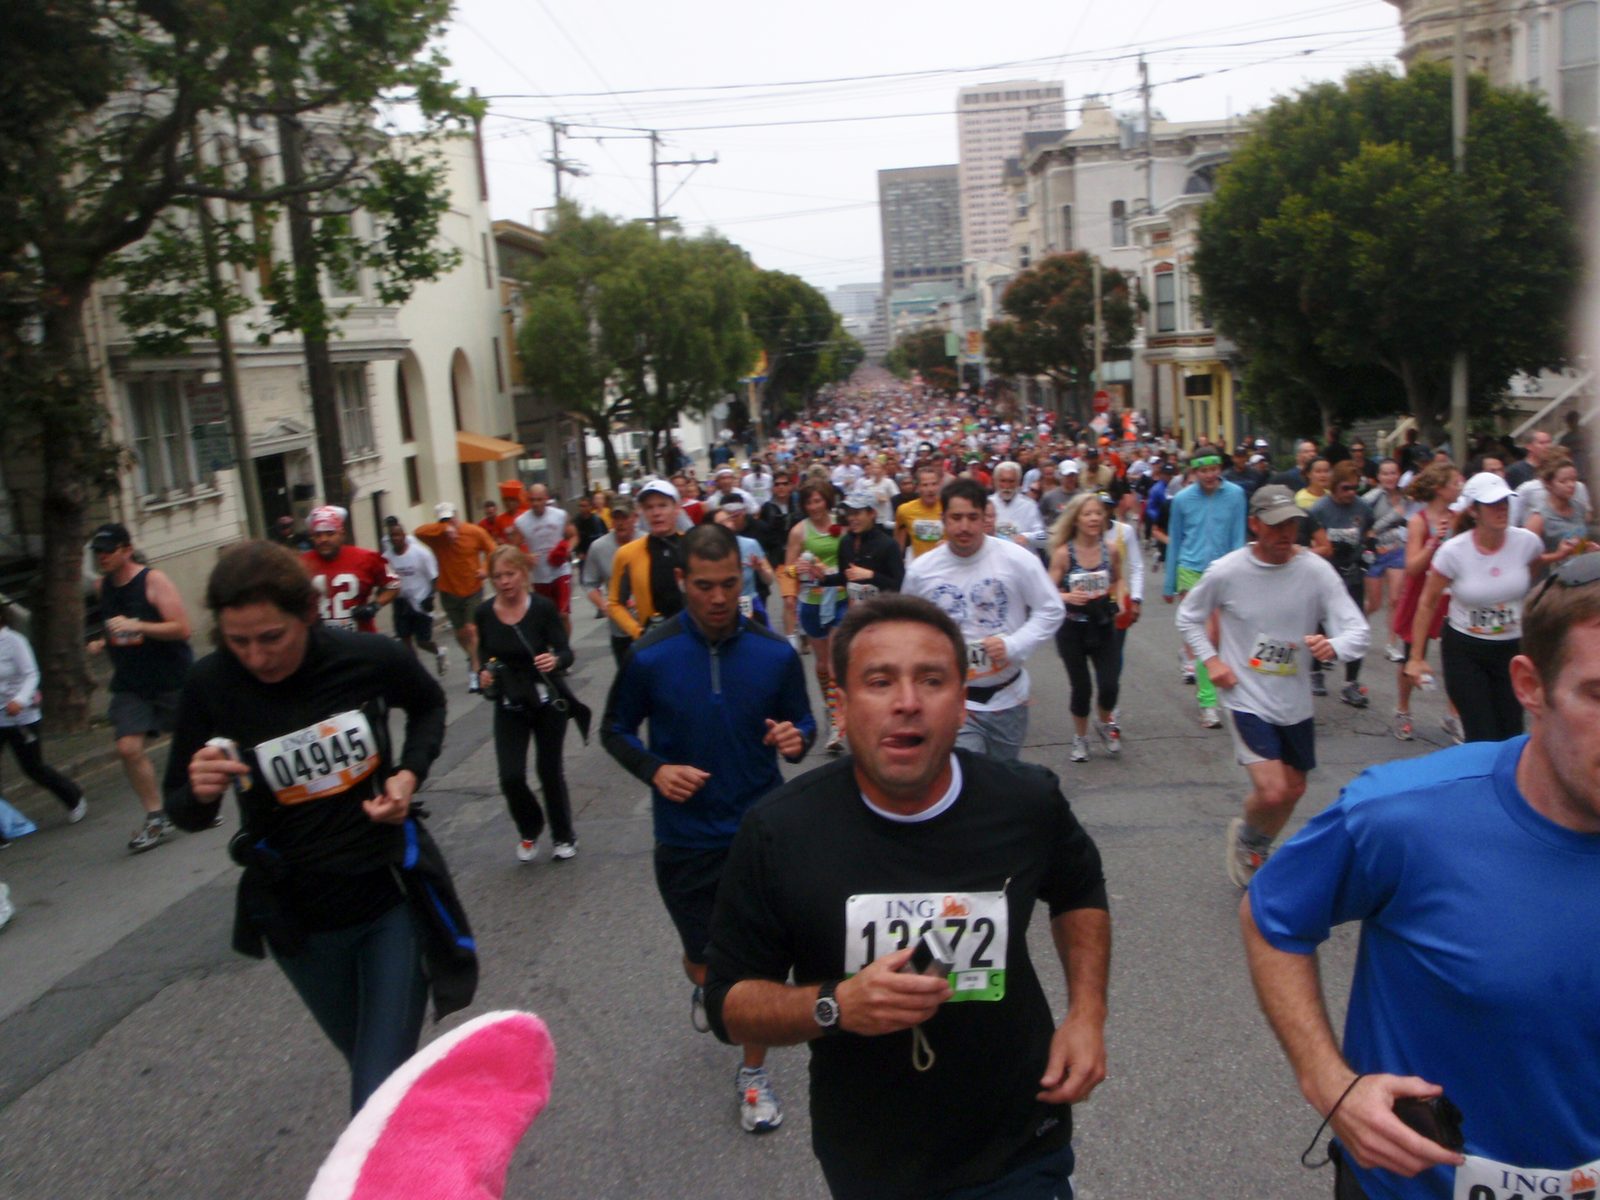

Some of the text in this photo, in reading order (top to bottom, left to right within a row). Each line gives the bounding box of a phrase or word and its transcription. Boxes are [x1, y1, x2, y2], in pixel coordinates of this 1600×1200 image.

[271, 727, 369, 787] 04945
[885, 899, 935, 918] ING
[1500, 1170, 1561, 1195] ING
